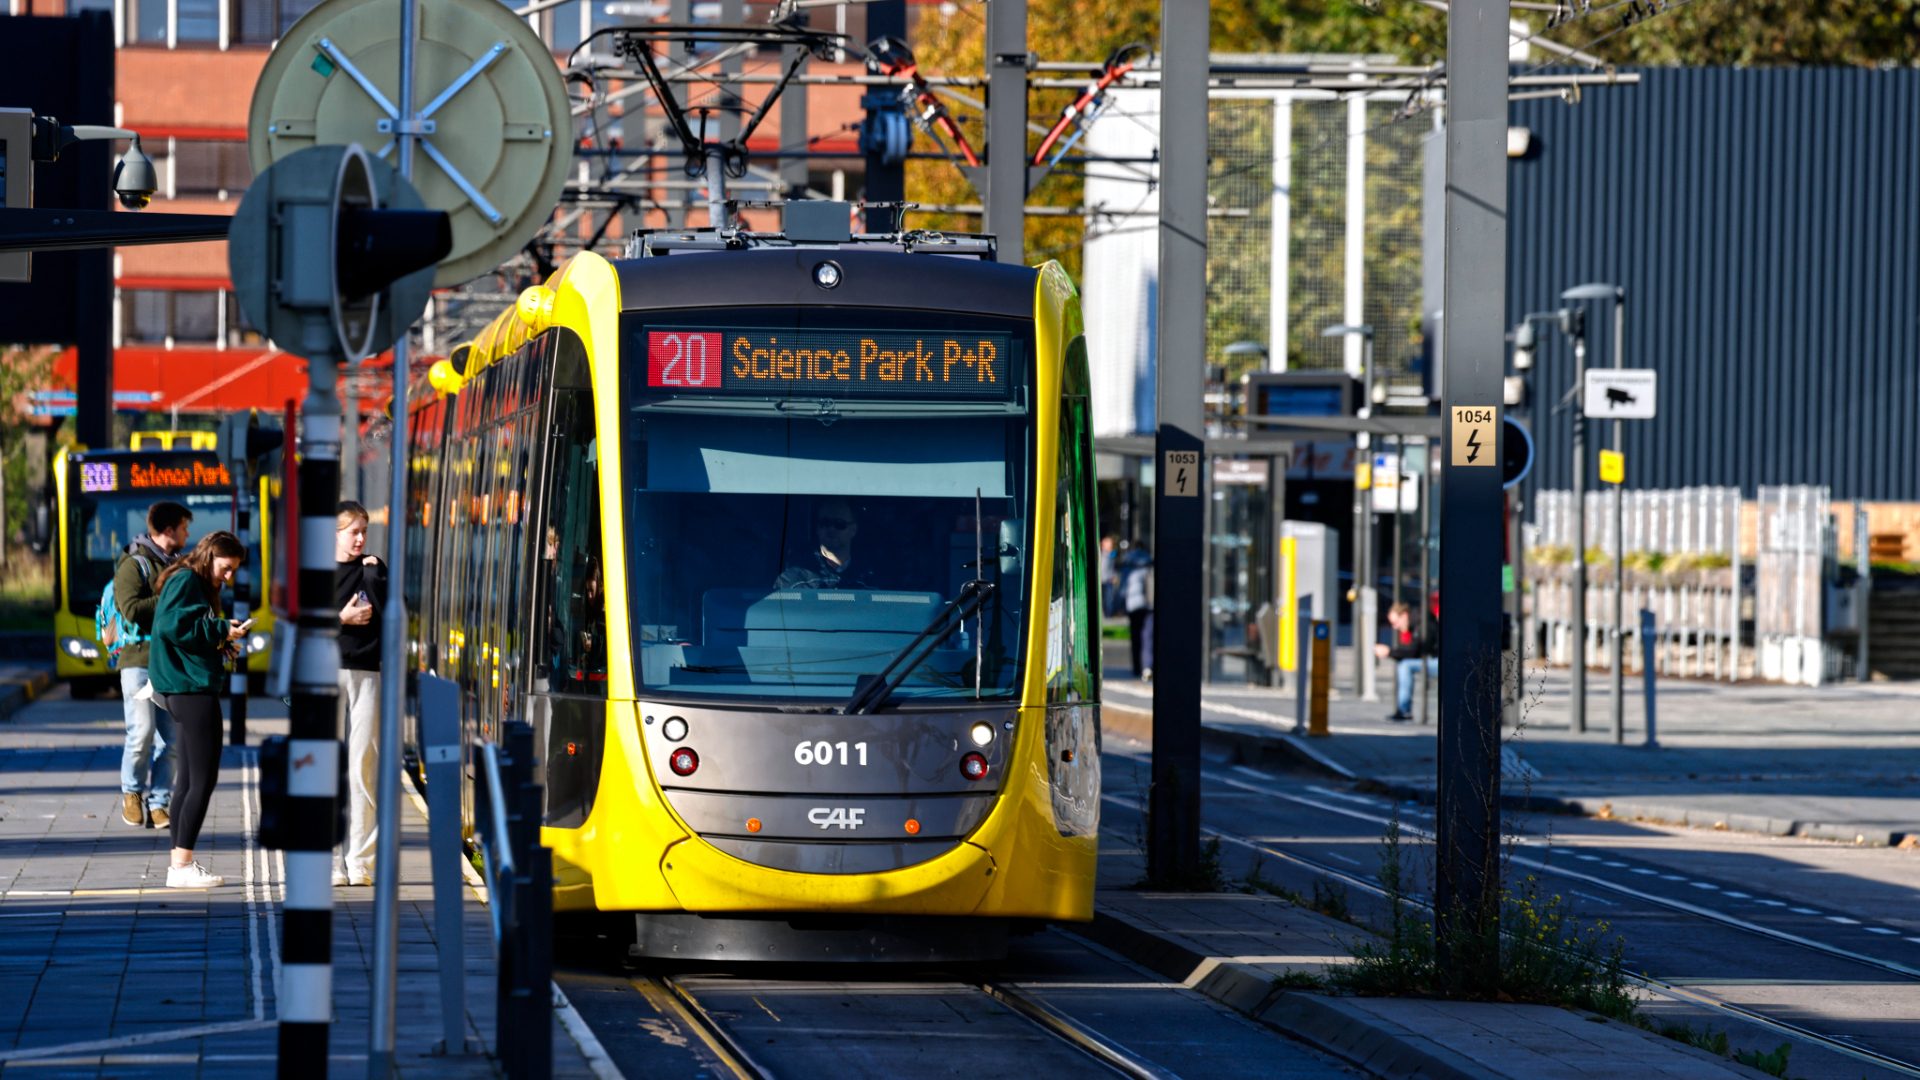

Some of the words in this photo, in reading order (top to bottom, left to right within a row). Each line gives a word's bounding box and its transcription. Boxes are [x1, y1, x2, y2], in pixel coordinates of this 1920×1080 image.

[662, 335, 707, 385] 20
[733, 337, 850, 380] Science
[860, 339, 933, 381] Park
[943, 340, 996, 382] P+R
[1456, 410, 1492, 423] 1054
[1169, 454, 1196, 464] 1053
[130, 462, 191, 487] Science
[193, 460, 230, 485] Park
[794, 741, 867, 766] 6011
[808, 807, 865, 829] CAF
